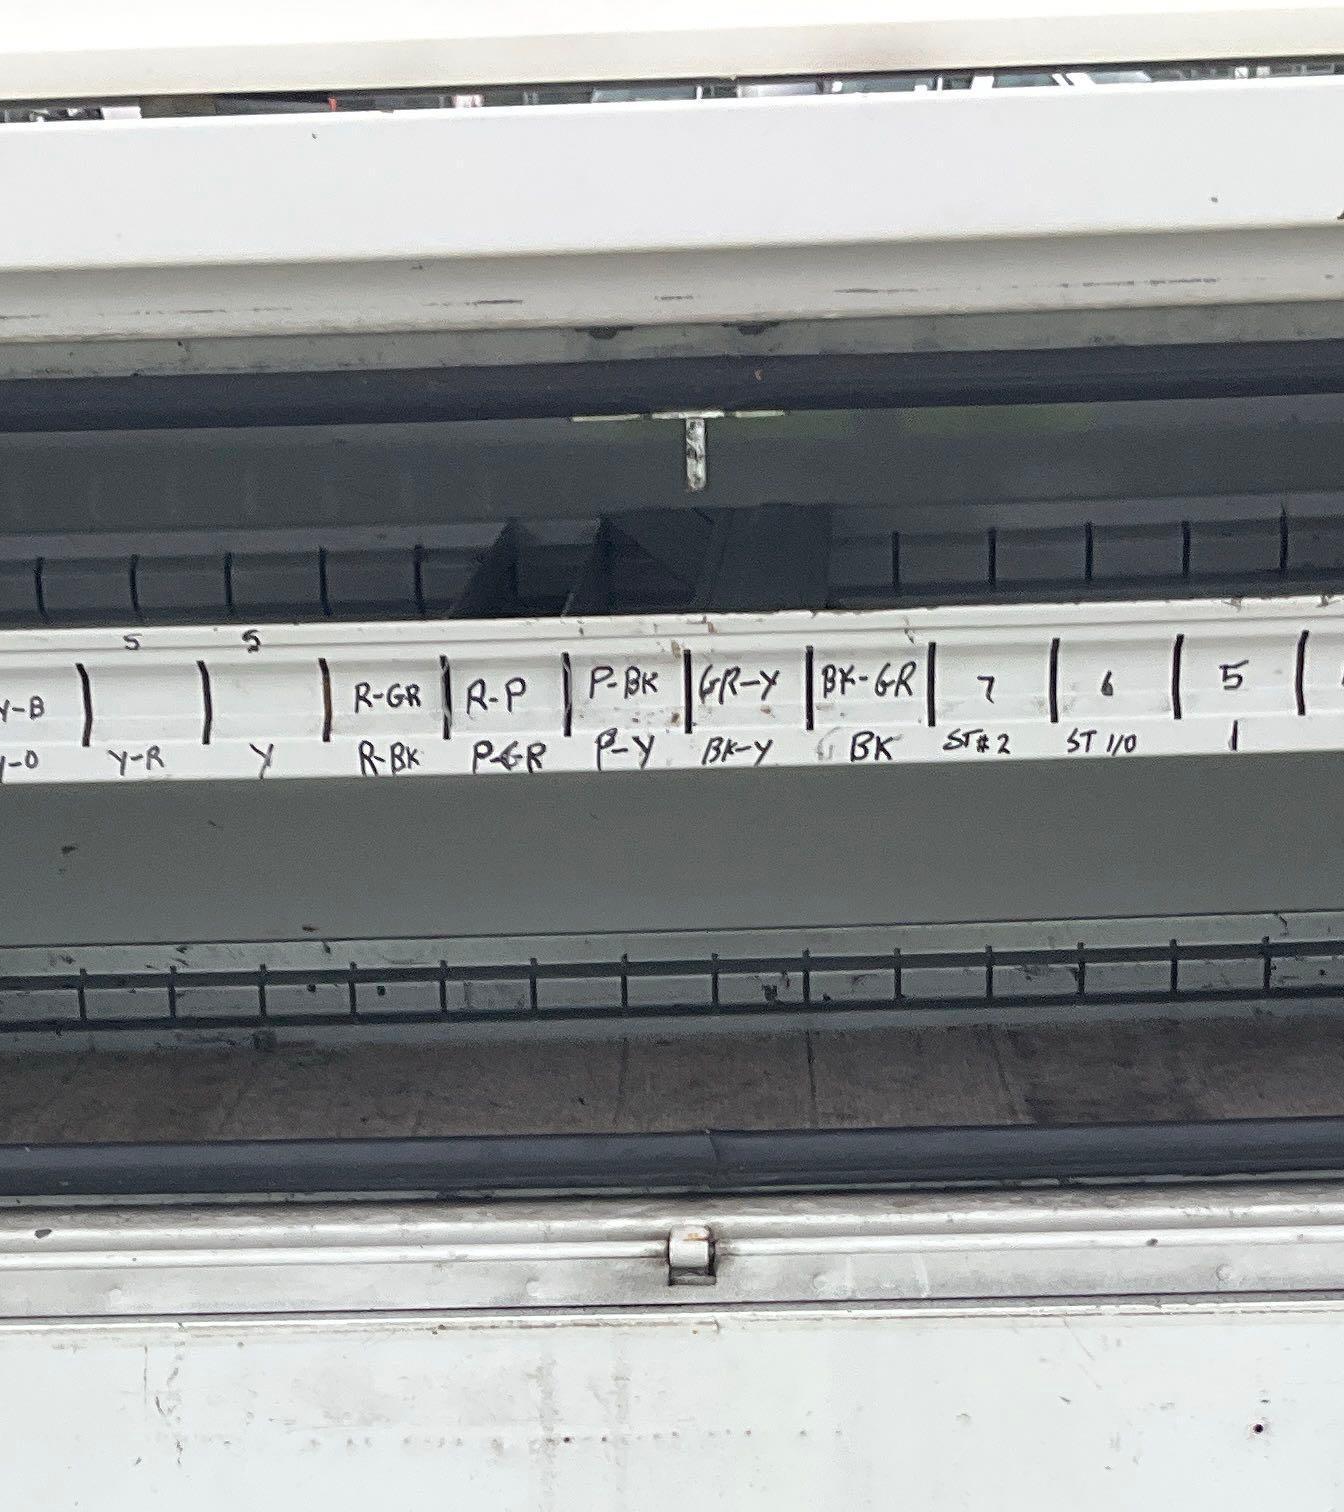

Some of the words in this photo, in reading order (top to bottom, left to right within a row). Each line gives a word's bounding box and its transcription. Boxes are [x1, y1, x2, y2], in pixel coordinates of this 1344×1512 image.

[123, 633, 141, 650] S
[242, 629, 261, 652] S
[589, 665, 658, 699] P-BK
[699, 664, 780, 705] GR-Y
[822, 661, 917, 699] BK-GR
[977, 675, 995, 705] 7
[1101, 669, 1114, 697] 6
[1219, 660, 1249, 690] 5
[355, 682, 422, 713] R-GR
[466, 677, 527, 715] R-P
[108, 745, 165, 776] Y-R
[250, 743, 273, 779] Y
[358, 740, 421, 776] R-BK
[596, 728, 655, 772] P-Y
[701, 737, 774, 766] BK-Y
[850, 730, 894, 762] BK
